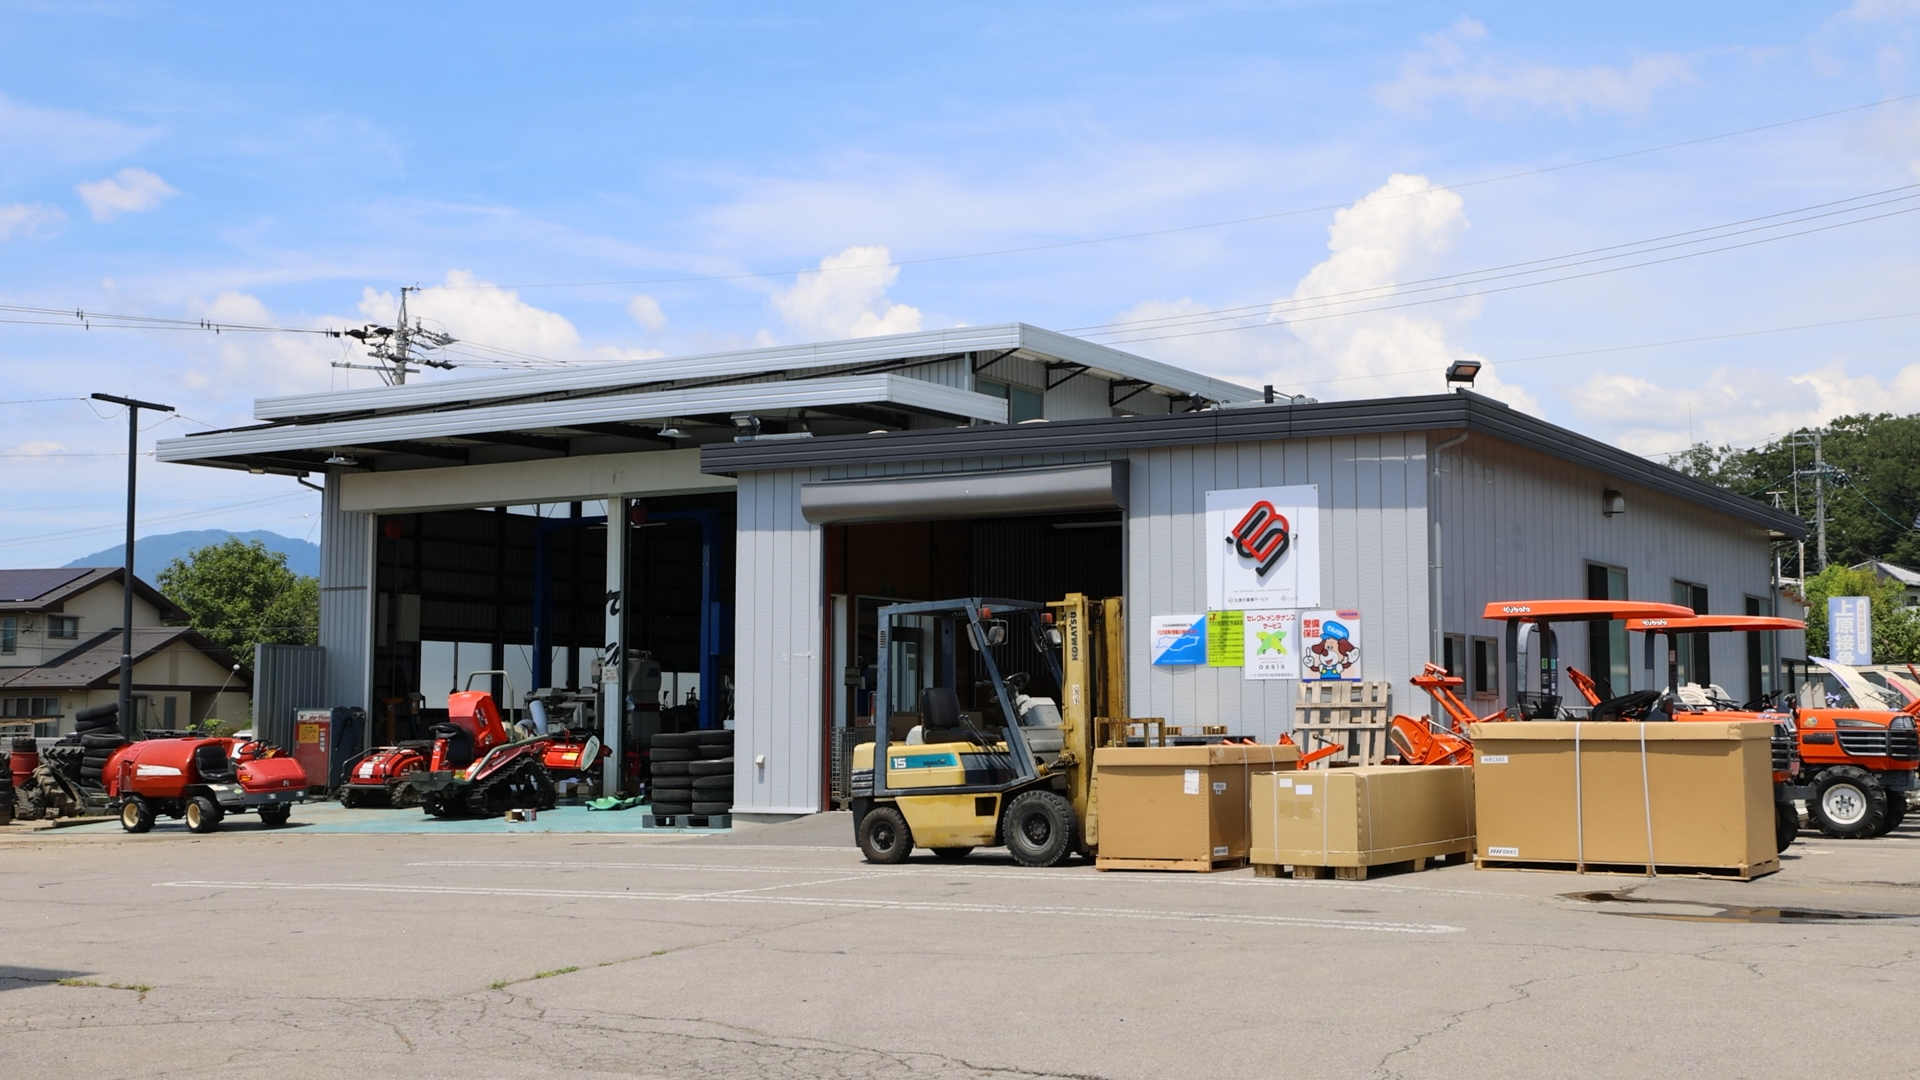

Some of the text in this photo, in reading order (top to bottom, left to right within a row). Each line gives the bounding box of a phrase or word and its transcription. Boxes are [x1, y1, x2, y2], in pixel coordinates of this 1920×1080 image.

[1503, 606, 1531, 614] Kubota
[1303, 619, 1320, 628] 整備
[1069, 611, 1078, 661] KOMATSU
[1303, 629, 1320, 638] 保証
[893, 758, 906, 769] 15
